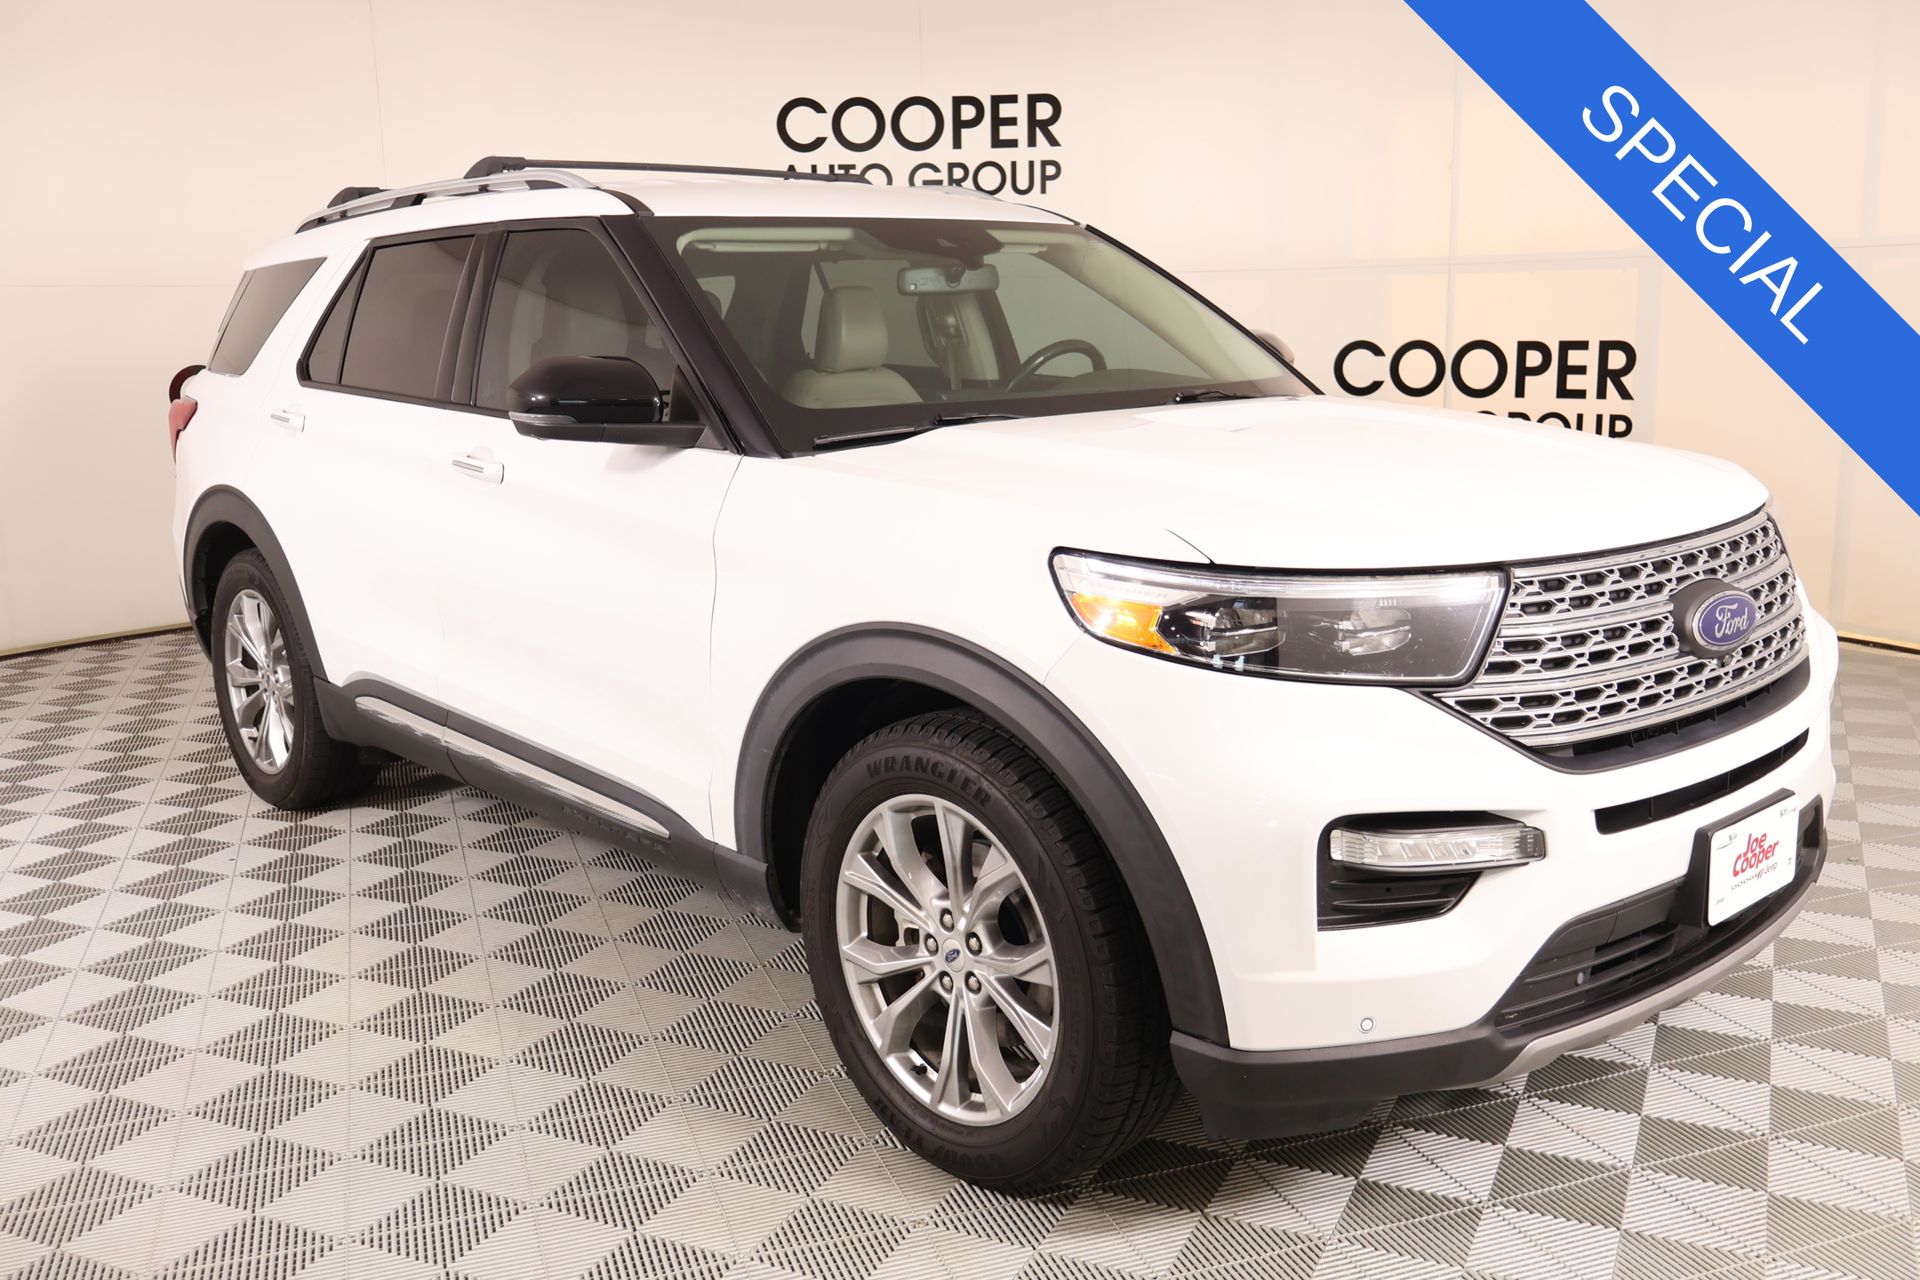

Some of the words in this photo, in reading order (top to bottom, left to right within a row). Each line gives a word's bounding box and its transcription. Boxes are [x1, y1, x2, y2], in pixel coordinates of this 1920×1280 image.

[776, 93, 1062, 153] COOPER
[908, 159, 1062, 196] GROUP
[1333, 339, 1637, 401] COOPER
[1714, 602, 1750, 639] Ford
[865, 754, 992, 810] WRANGLER
[1732, 840, 1780, 878] Cooper
[1742, 832, 1768, 858] Joe
